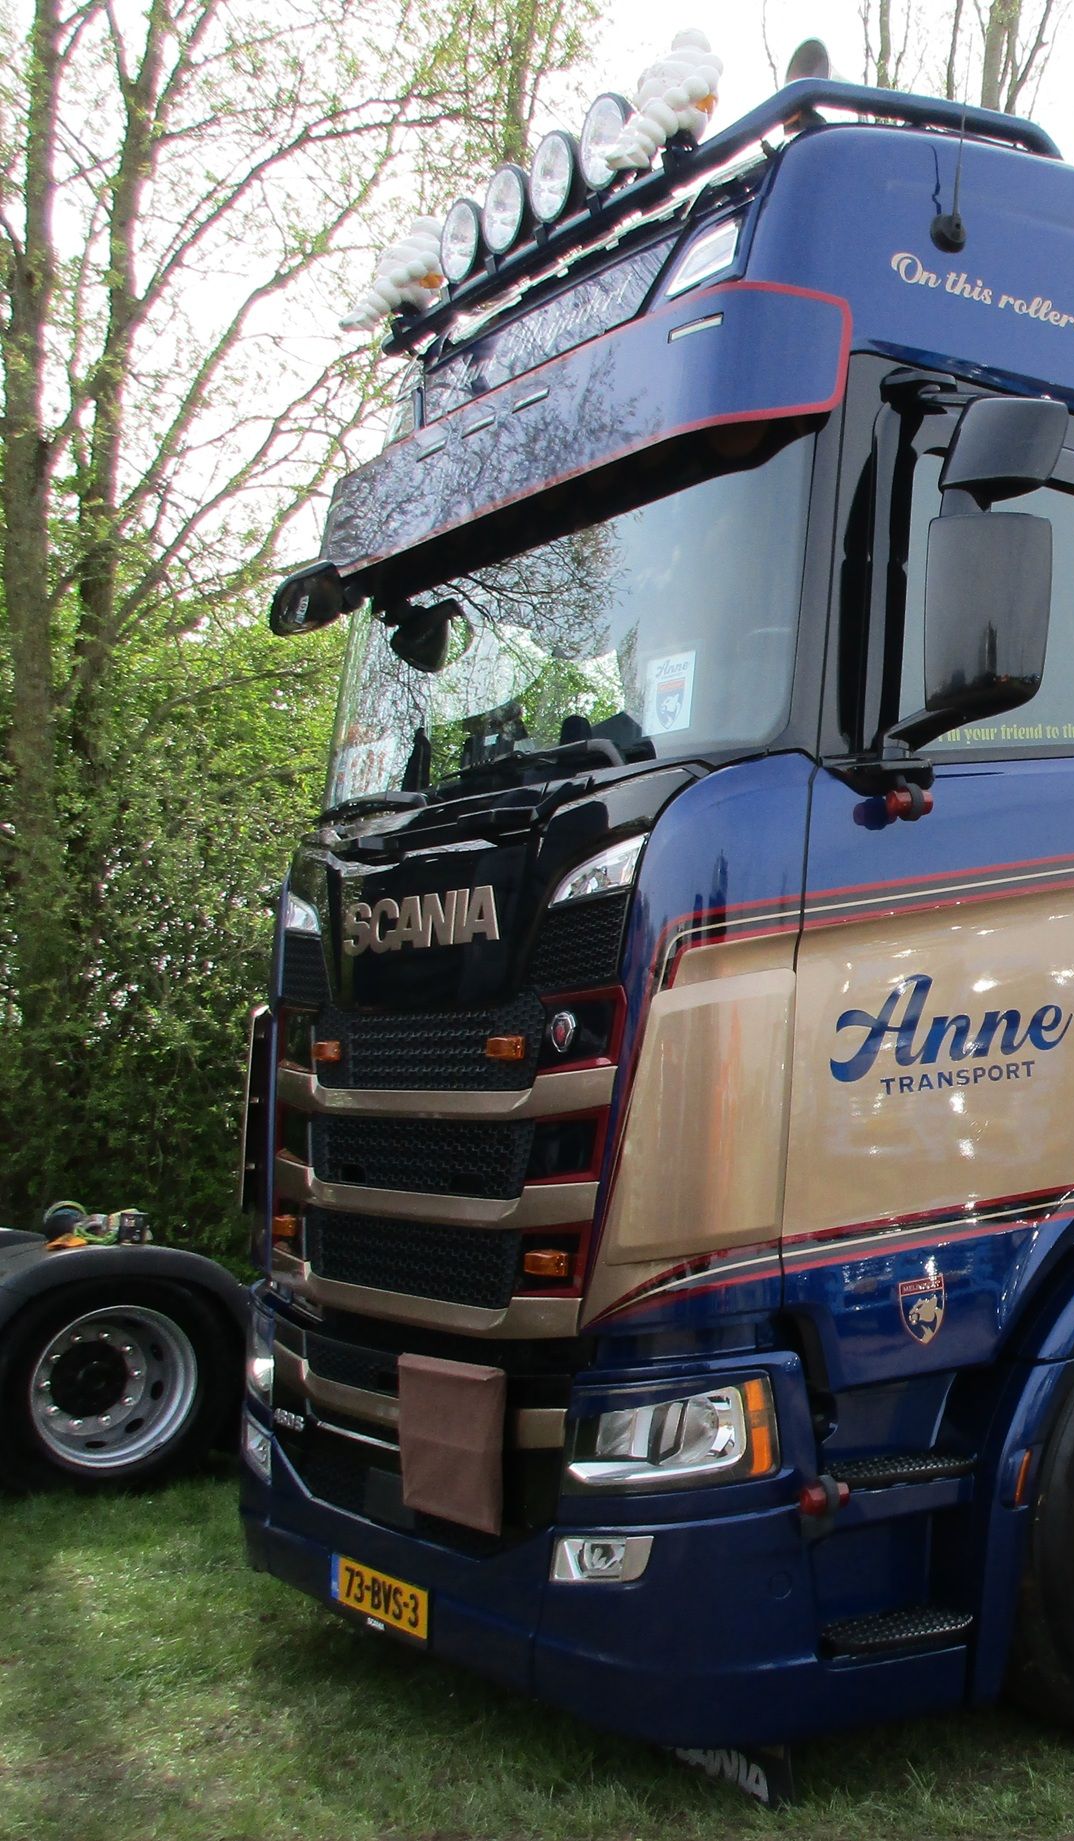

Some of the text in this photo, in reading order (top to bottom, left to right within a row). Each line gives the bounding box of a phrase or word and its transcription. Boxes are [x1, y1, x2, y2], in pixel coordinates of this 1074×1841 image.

[891, 252, 942, 288] On
[945, 271, 992, 305] this
[964, 728, 997, 744] your
[1000, 723, 1043, 740] friend
[1045, 725, 1060, 739] to
[344, 884, 500, 957] SCANIA
[830, 973, 1073, 1082] Anne
[880, 1060, 1036, 1096] TRANSPORT
